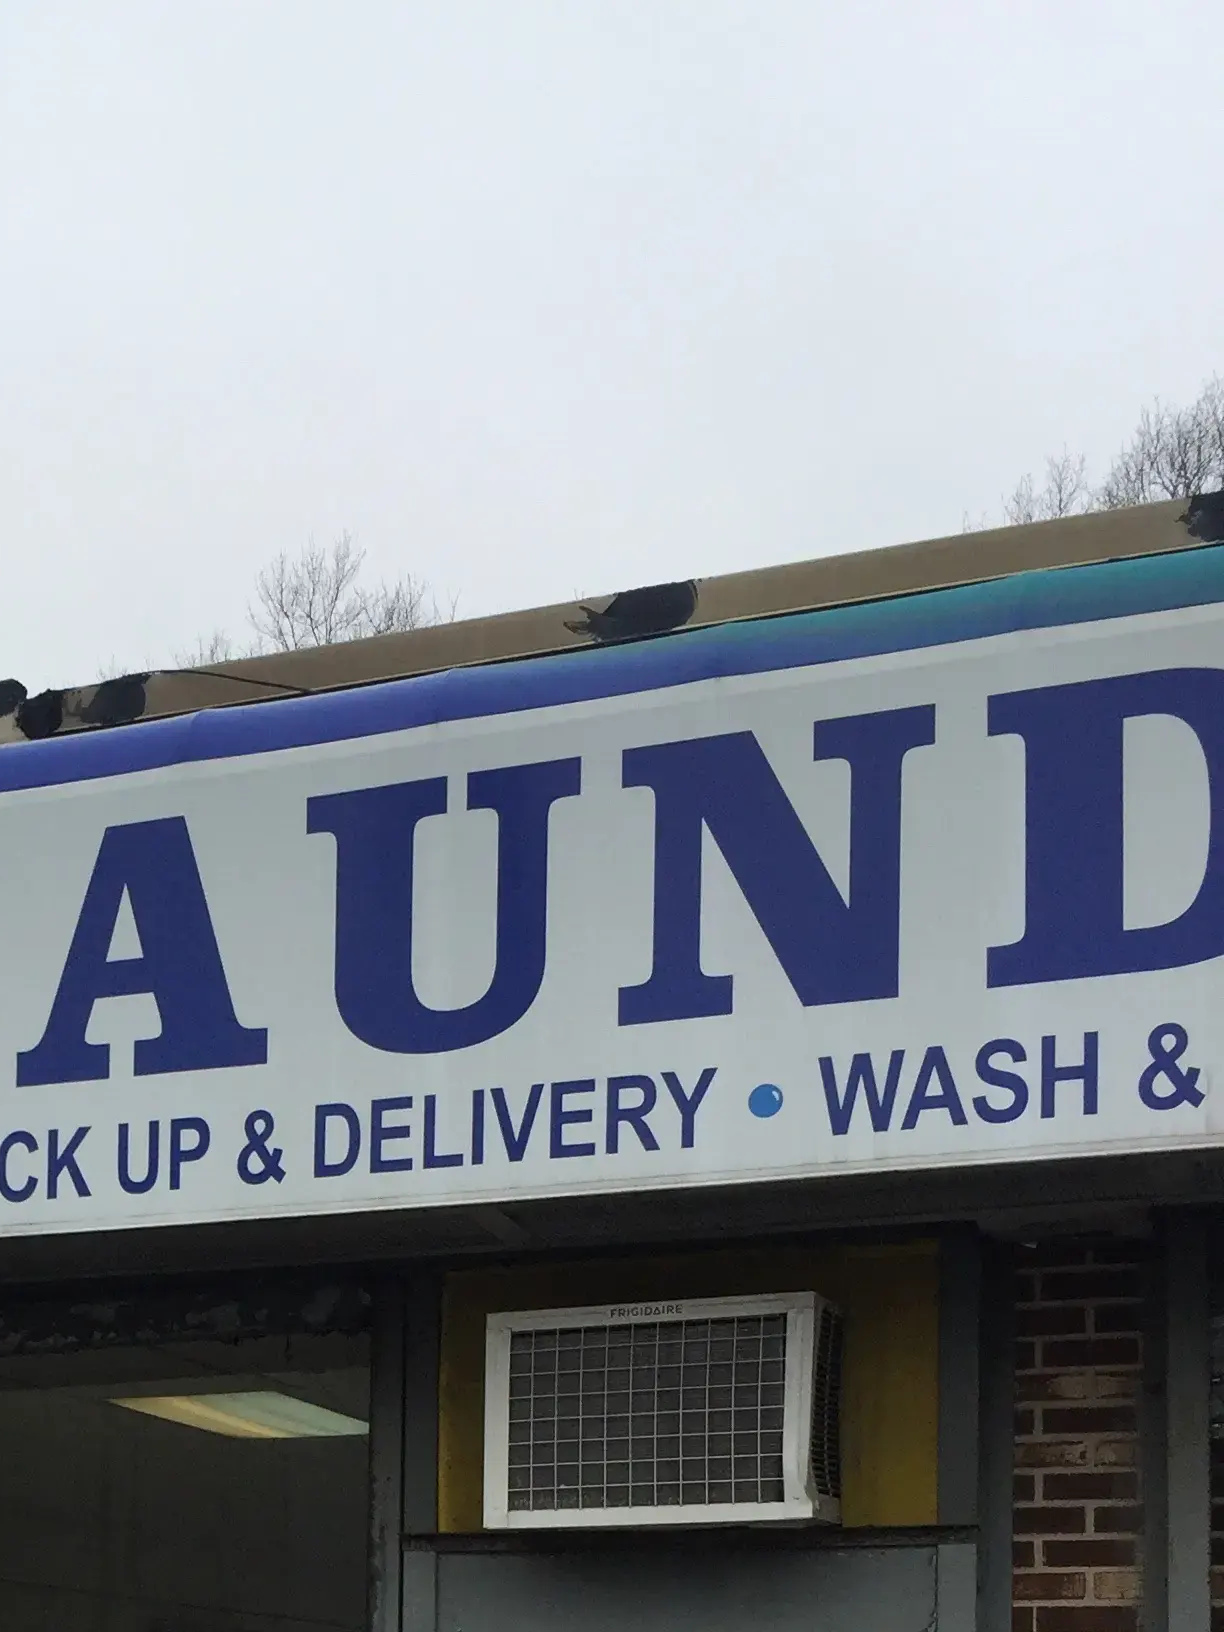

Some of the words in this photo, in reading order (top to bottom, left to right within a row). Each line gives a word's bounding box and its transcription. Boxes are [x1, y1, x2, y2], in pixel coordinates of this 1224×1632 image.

[117, 1117, 211, 1195] UP
[236, 1109, 286, 1185] &
[313, 1067, 718, 1178] DELIVERY
[818, 1031, 1100, 1136] WASH
[1138, 1022, 1206, 1111] &
[610, 1304, 683, 1318] FRIGIDAIRE
